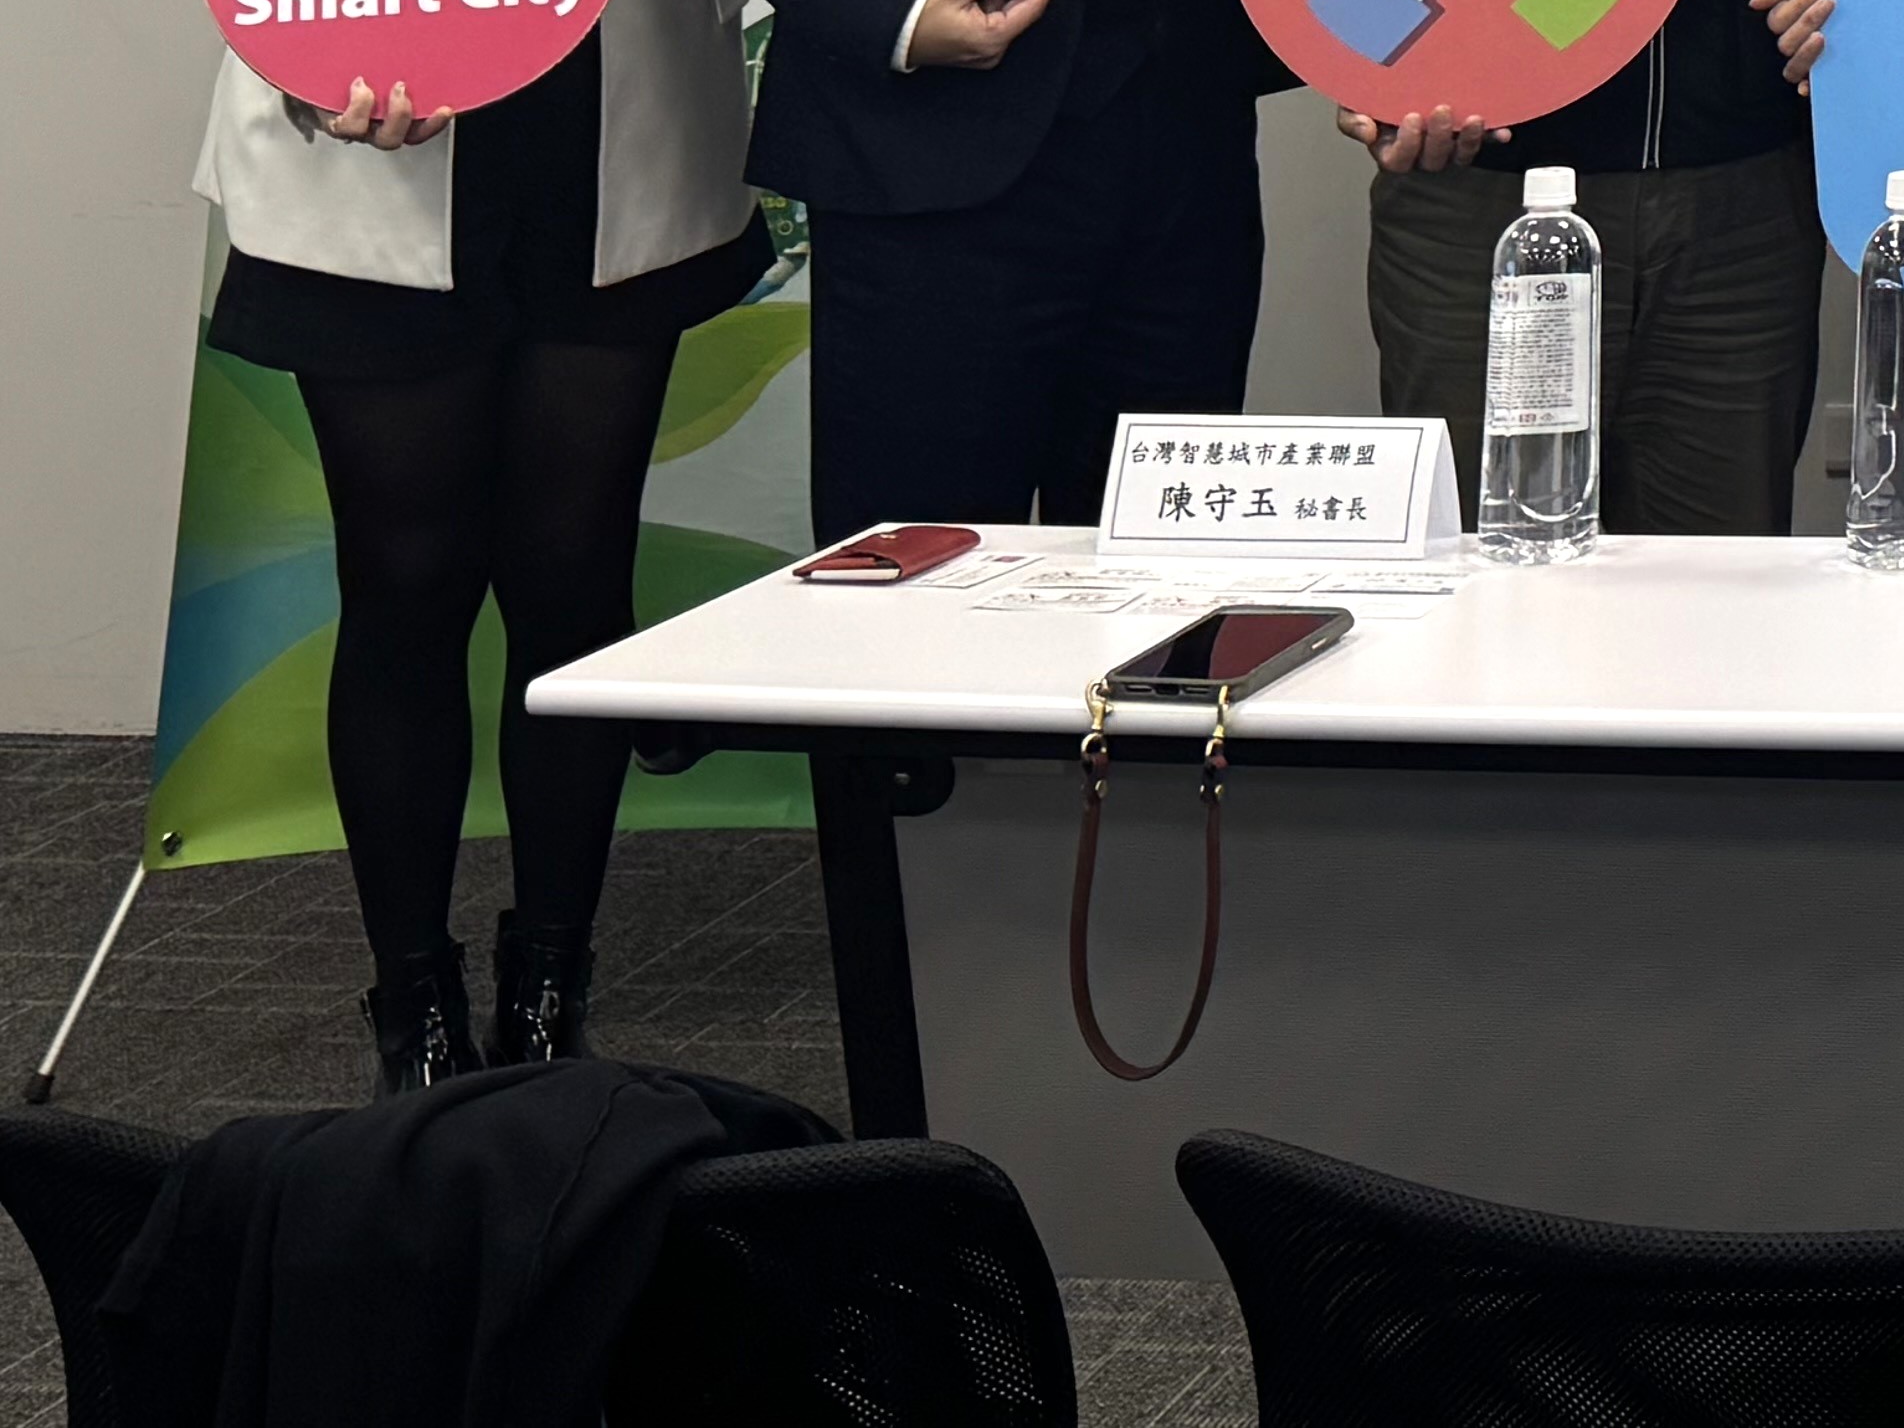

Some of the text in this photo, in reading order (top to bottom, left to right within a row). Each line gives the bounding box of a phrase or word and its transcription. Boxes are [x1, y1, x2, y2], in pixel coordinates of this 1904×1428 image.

[1131, 441, 1376, 466] 台灣智慧城市產業聯盟
[1158, 482, 1367, 523] 陳守玉 秘書長
